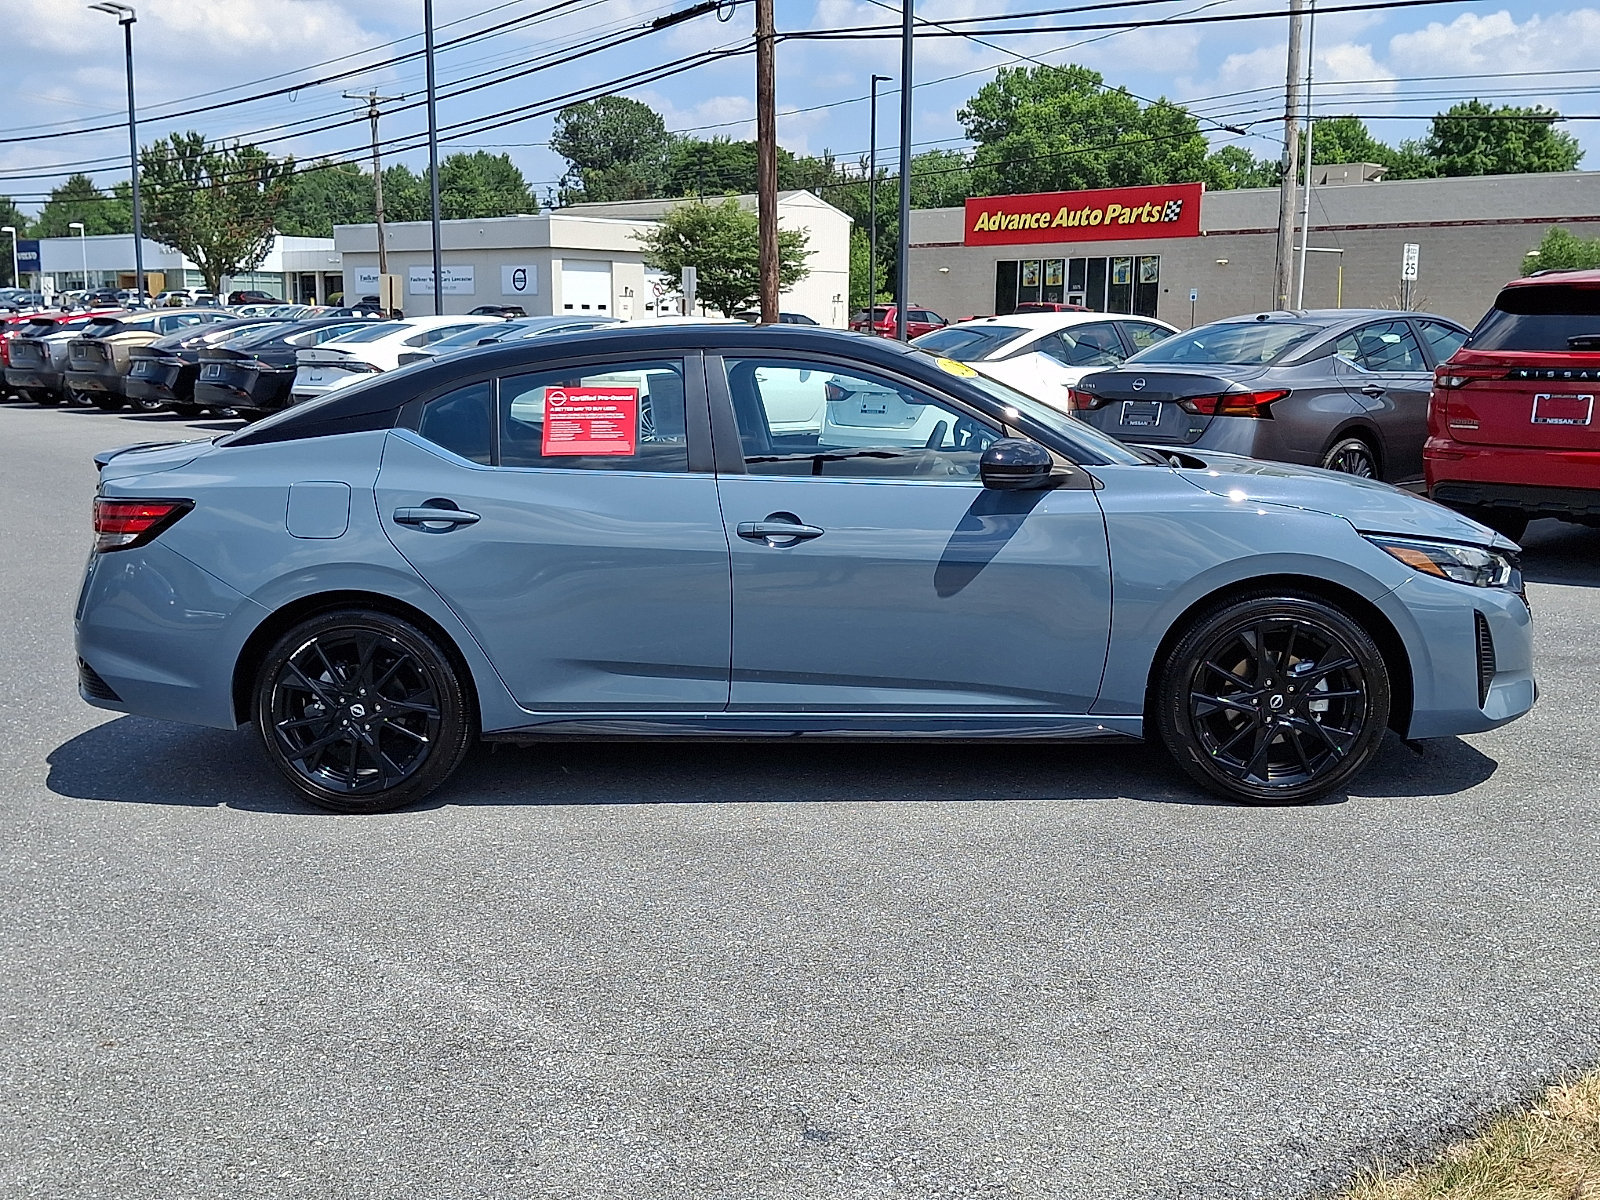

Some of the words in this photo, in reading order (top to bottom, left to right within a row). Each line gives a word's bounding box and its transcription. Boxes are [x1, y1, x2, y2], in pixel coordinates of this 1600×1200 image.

[973, 211, 1051, 232] Advance
[1051, 206, 1103, 228] Auto
[1104, 201, 1161, 225] Parts
[1405, 262, 1416, 275] 25
